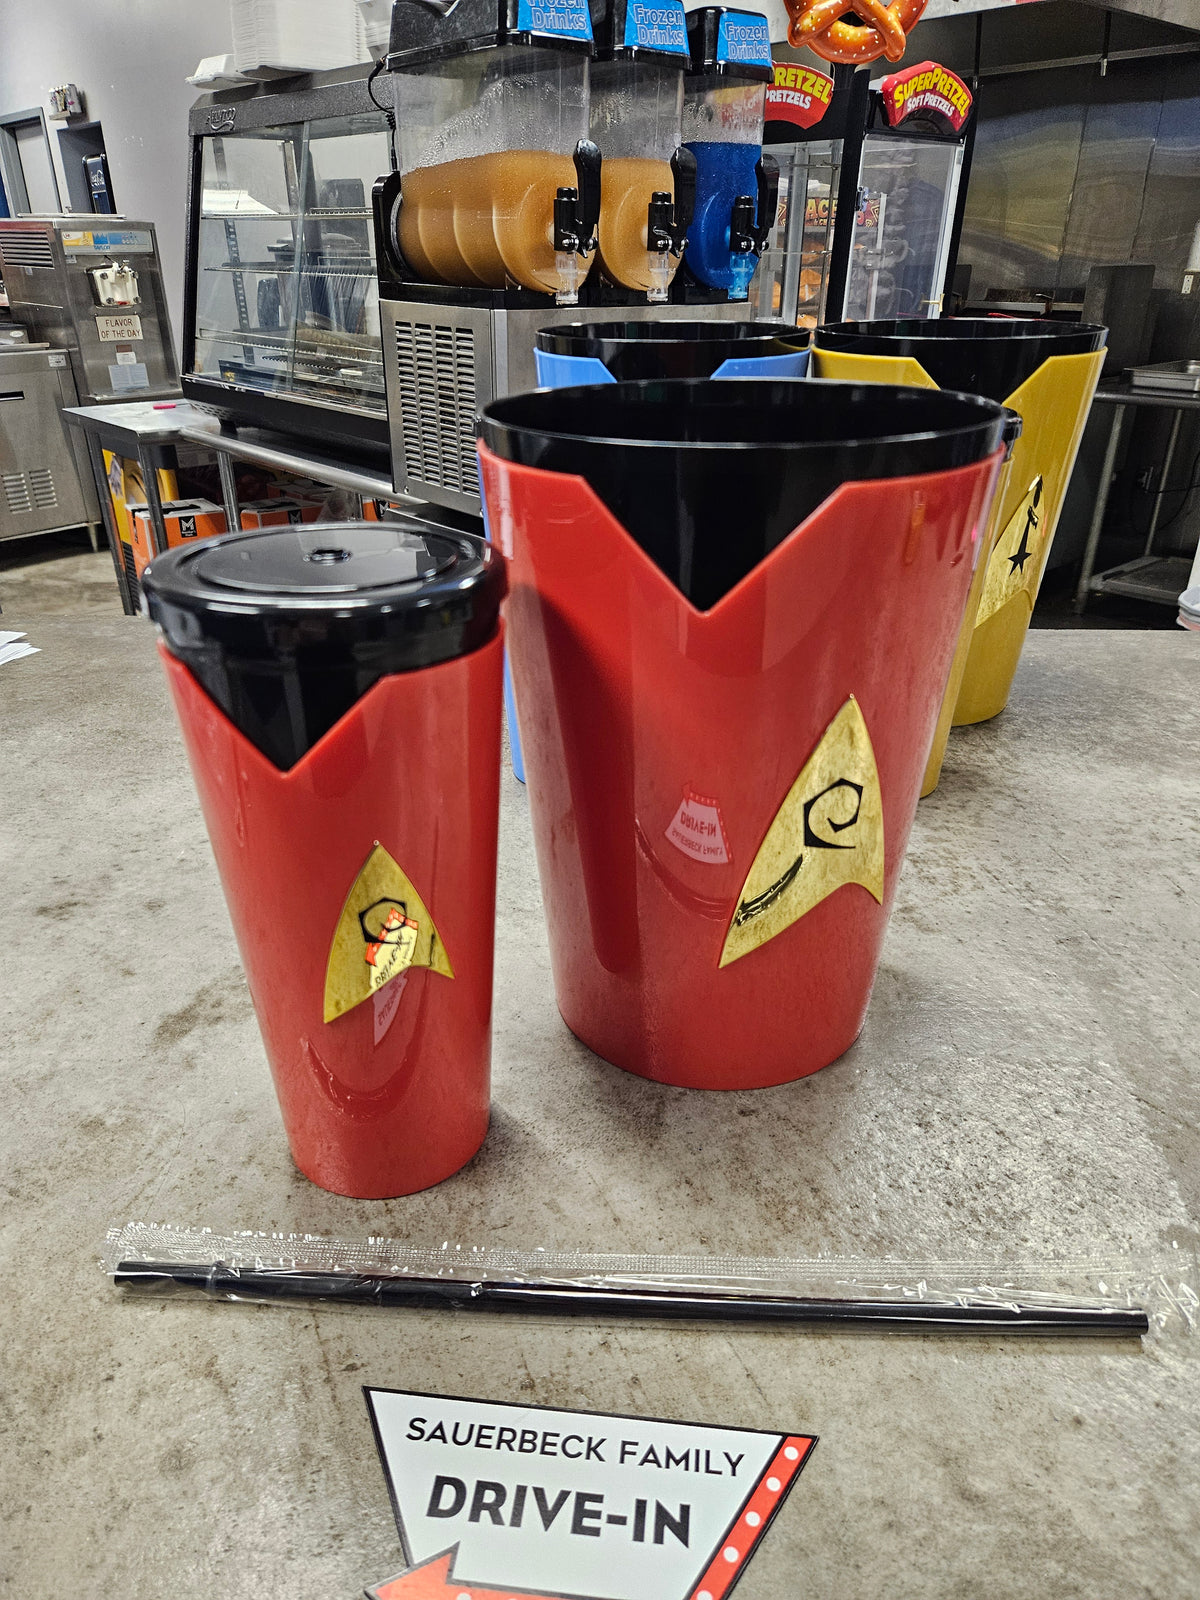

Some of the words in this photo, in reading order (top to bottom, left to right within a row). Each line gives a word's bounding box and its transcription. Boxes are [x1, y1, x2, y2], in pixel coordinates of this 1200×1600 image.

[528, 0, 585, 8] ozen
[633, 4, 684, 25] Frozen
[532, 7, 587, 30] Drinks
[637, 25, 685, 45] Drinks
[725, 21, 769, 40] Frozen
[728, 41, 769, 60] Drinks
[772, 66, 832, 104] RETZEL
[894, 67, 970, 117] SUPERPRETZEL
[907, 94, 925, 112] SOFT
[924, 92, 955, 117] PRETZELS
[105, 318, 133, 327] FLAVOR
[101, 330, 110, 338] OF
[112, 329, 125, 337] THE
[127, 329, 141, 337] DAY
[405, 1417, 607, 1462] SAUERBECK
[619, 1440, 745, 1477] FAMILY
[426, 1474, 691, 1548] DRIVE-IN
